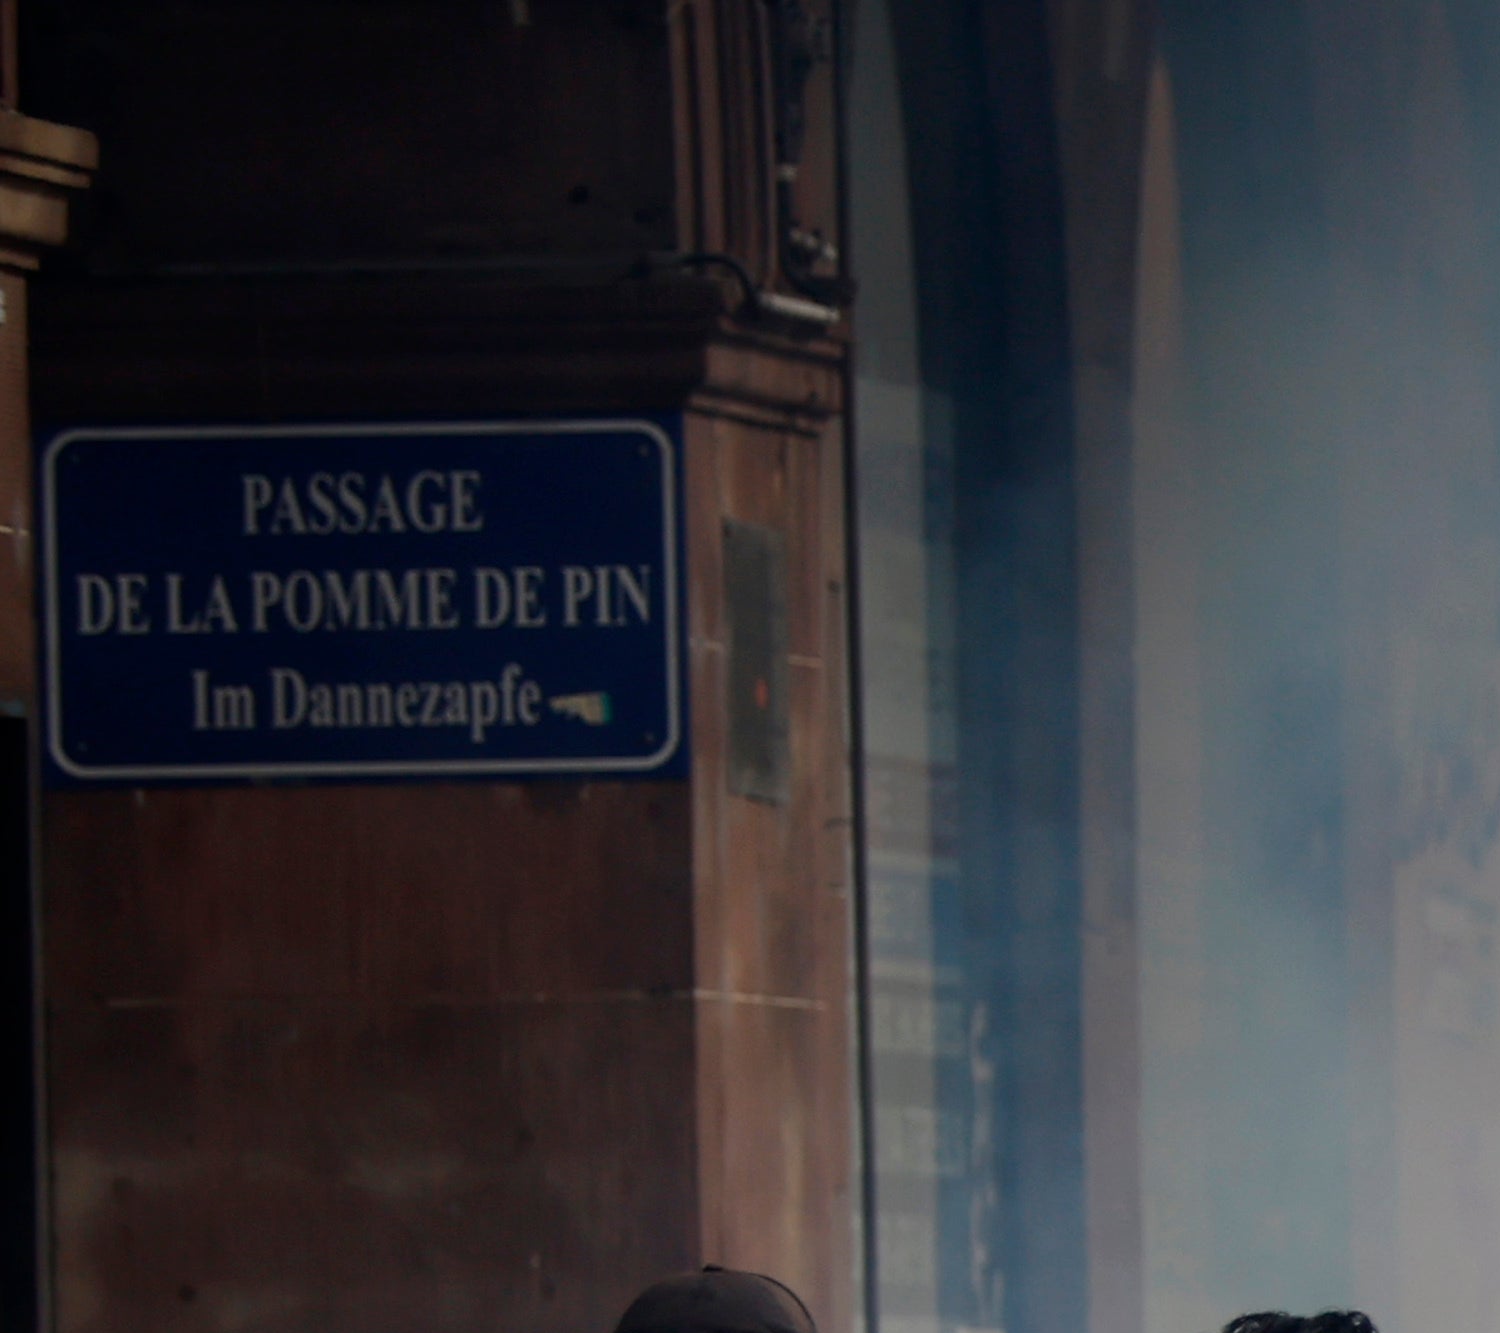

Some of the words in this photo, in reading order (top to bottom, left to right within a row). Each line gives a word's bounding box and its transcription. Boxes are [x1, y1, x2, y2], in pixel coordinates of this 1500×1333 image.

[244, 471, 482, 533] PASSAGE
[78, 575, 149, 634] DE
[167, 574, 237, 633] LA
[252, 568, 458, 631] POMME
[475, 566, 546, 628] DE
[562, 565, 650, 626] PIN
[193, 671, 253, 729] Im
[272, 663, 541, 743] Dannezapfe
